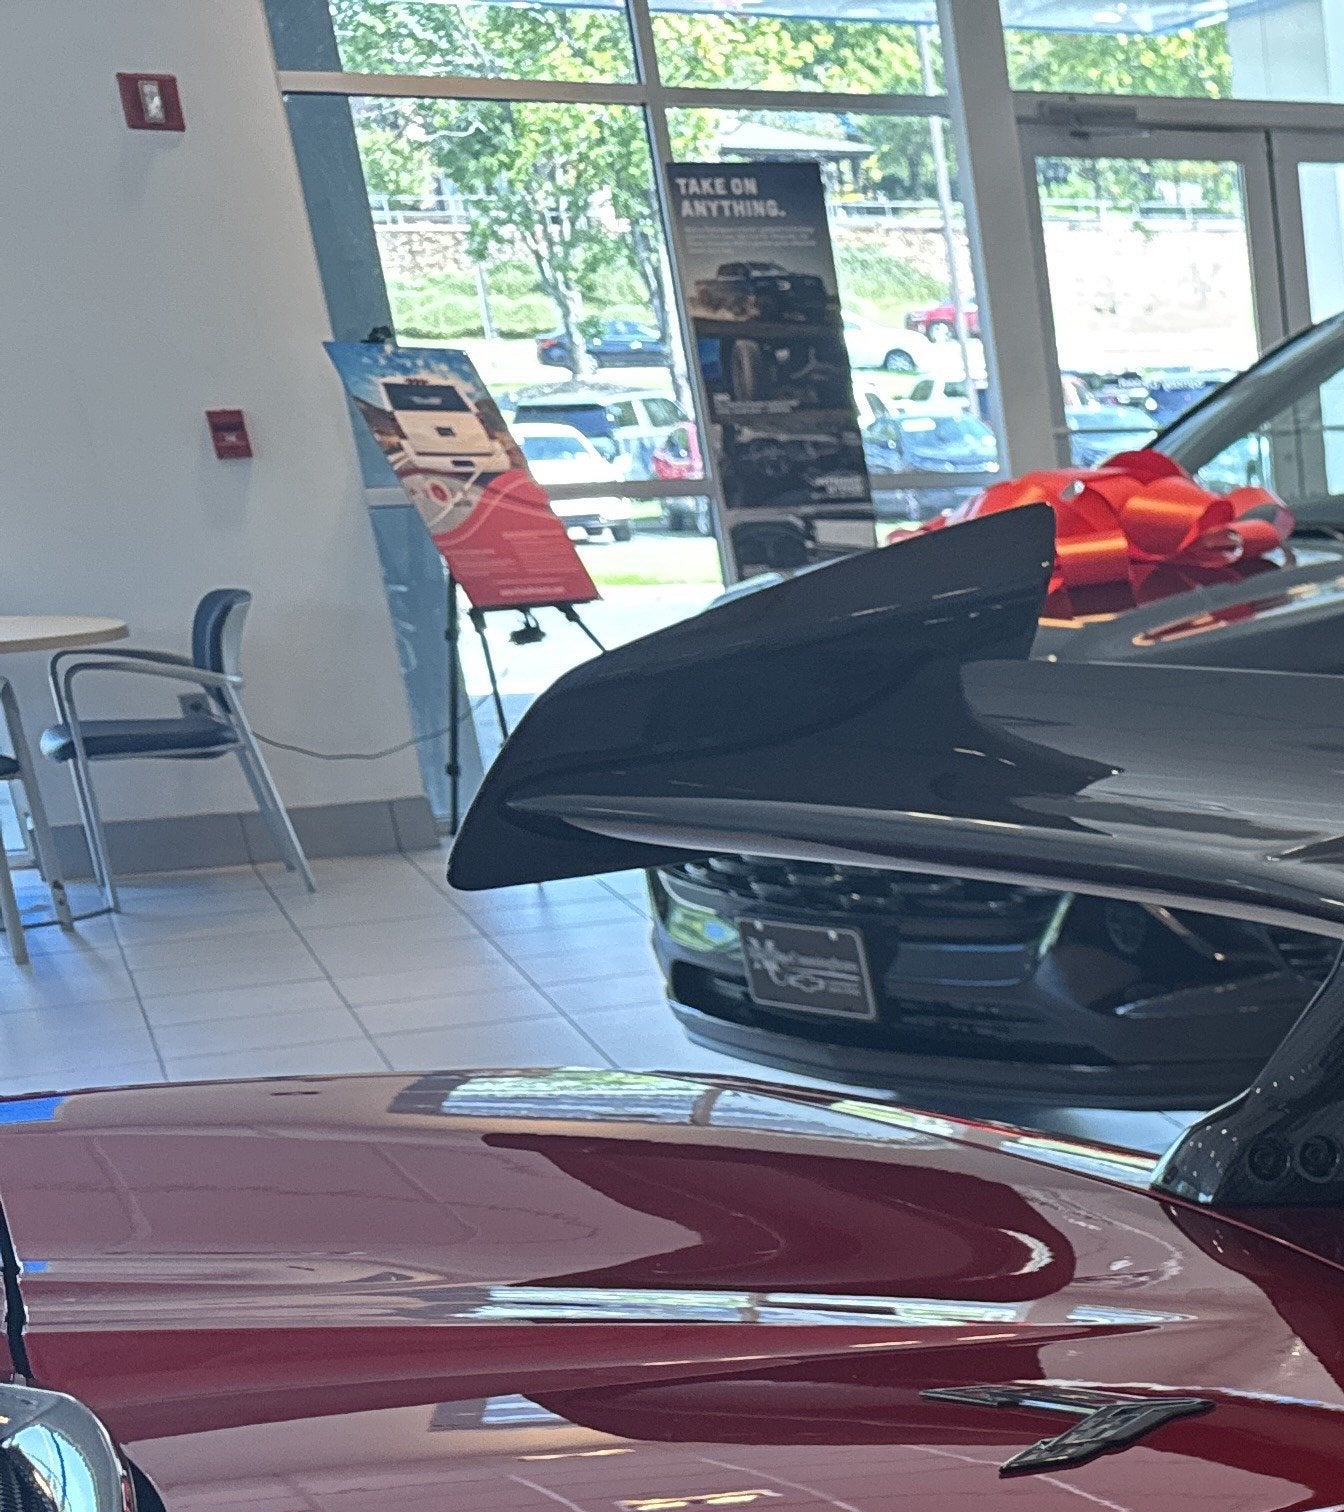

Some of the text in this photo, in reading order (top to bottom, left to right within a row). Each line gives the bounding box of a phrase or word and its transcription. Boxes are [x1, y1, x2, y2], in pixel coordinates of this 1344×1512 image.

[675, 177, 758, 196] TAKE ON
[681, 199, 786, 218] ANYTHING.
